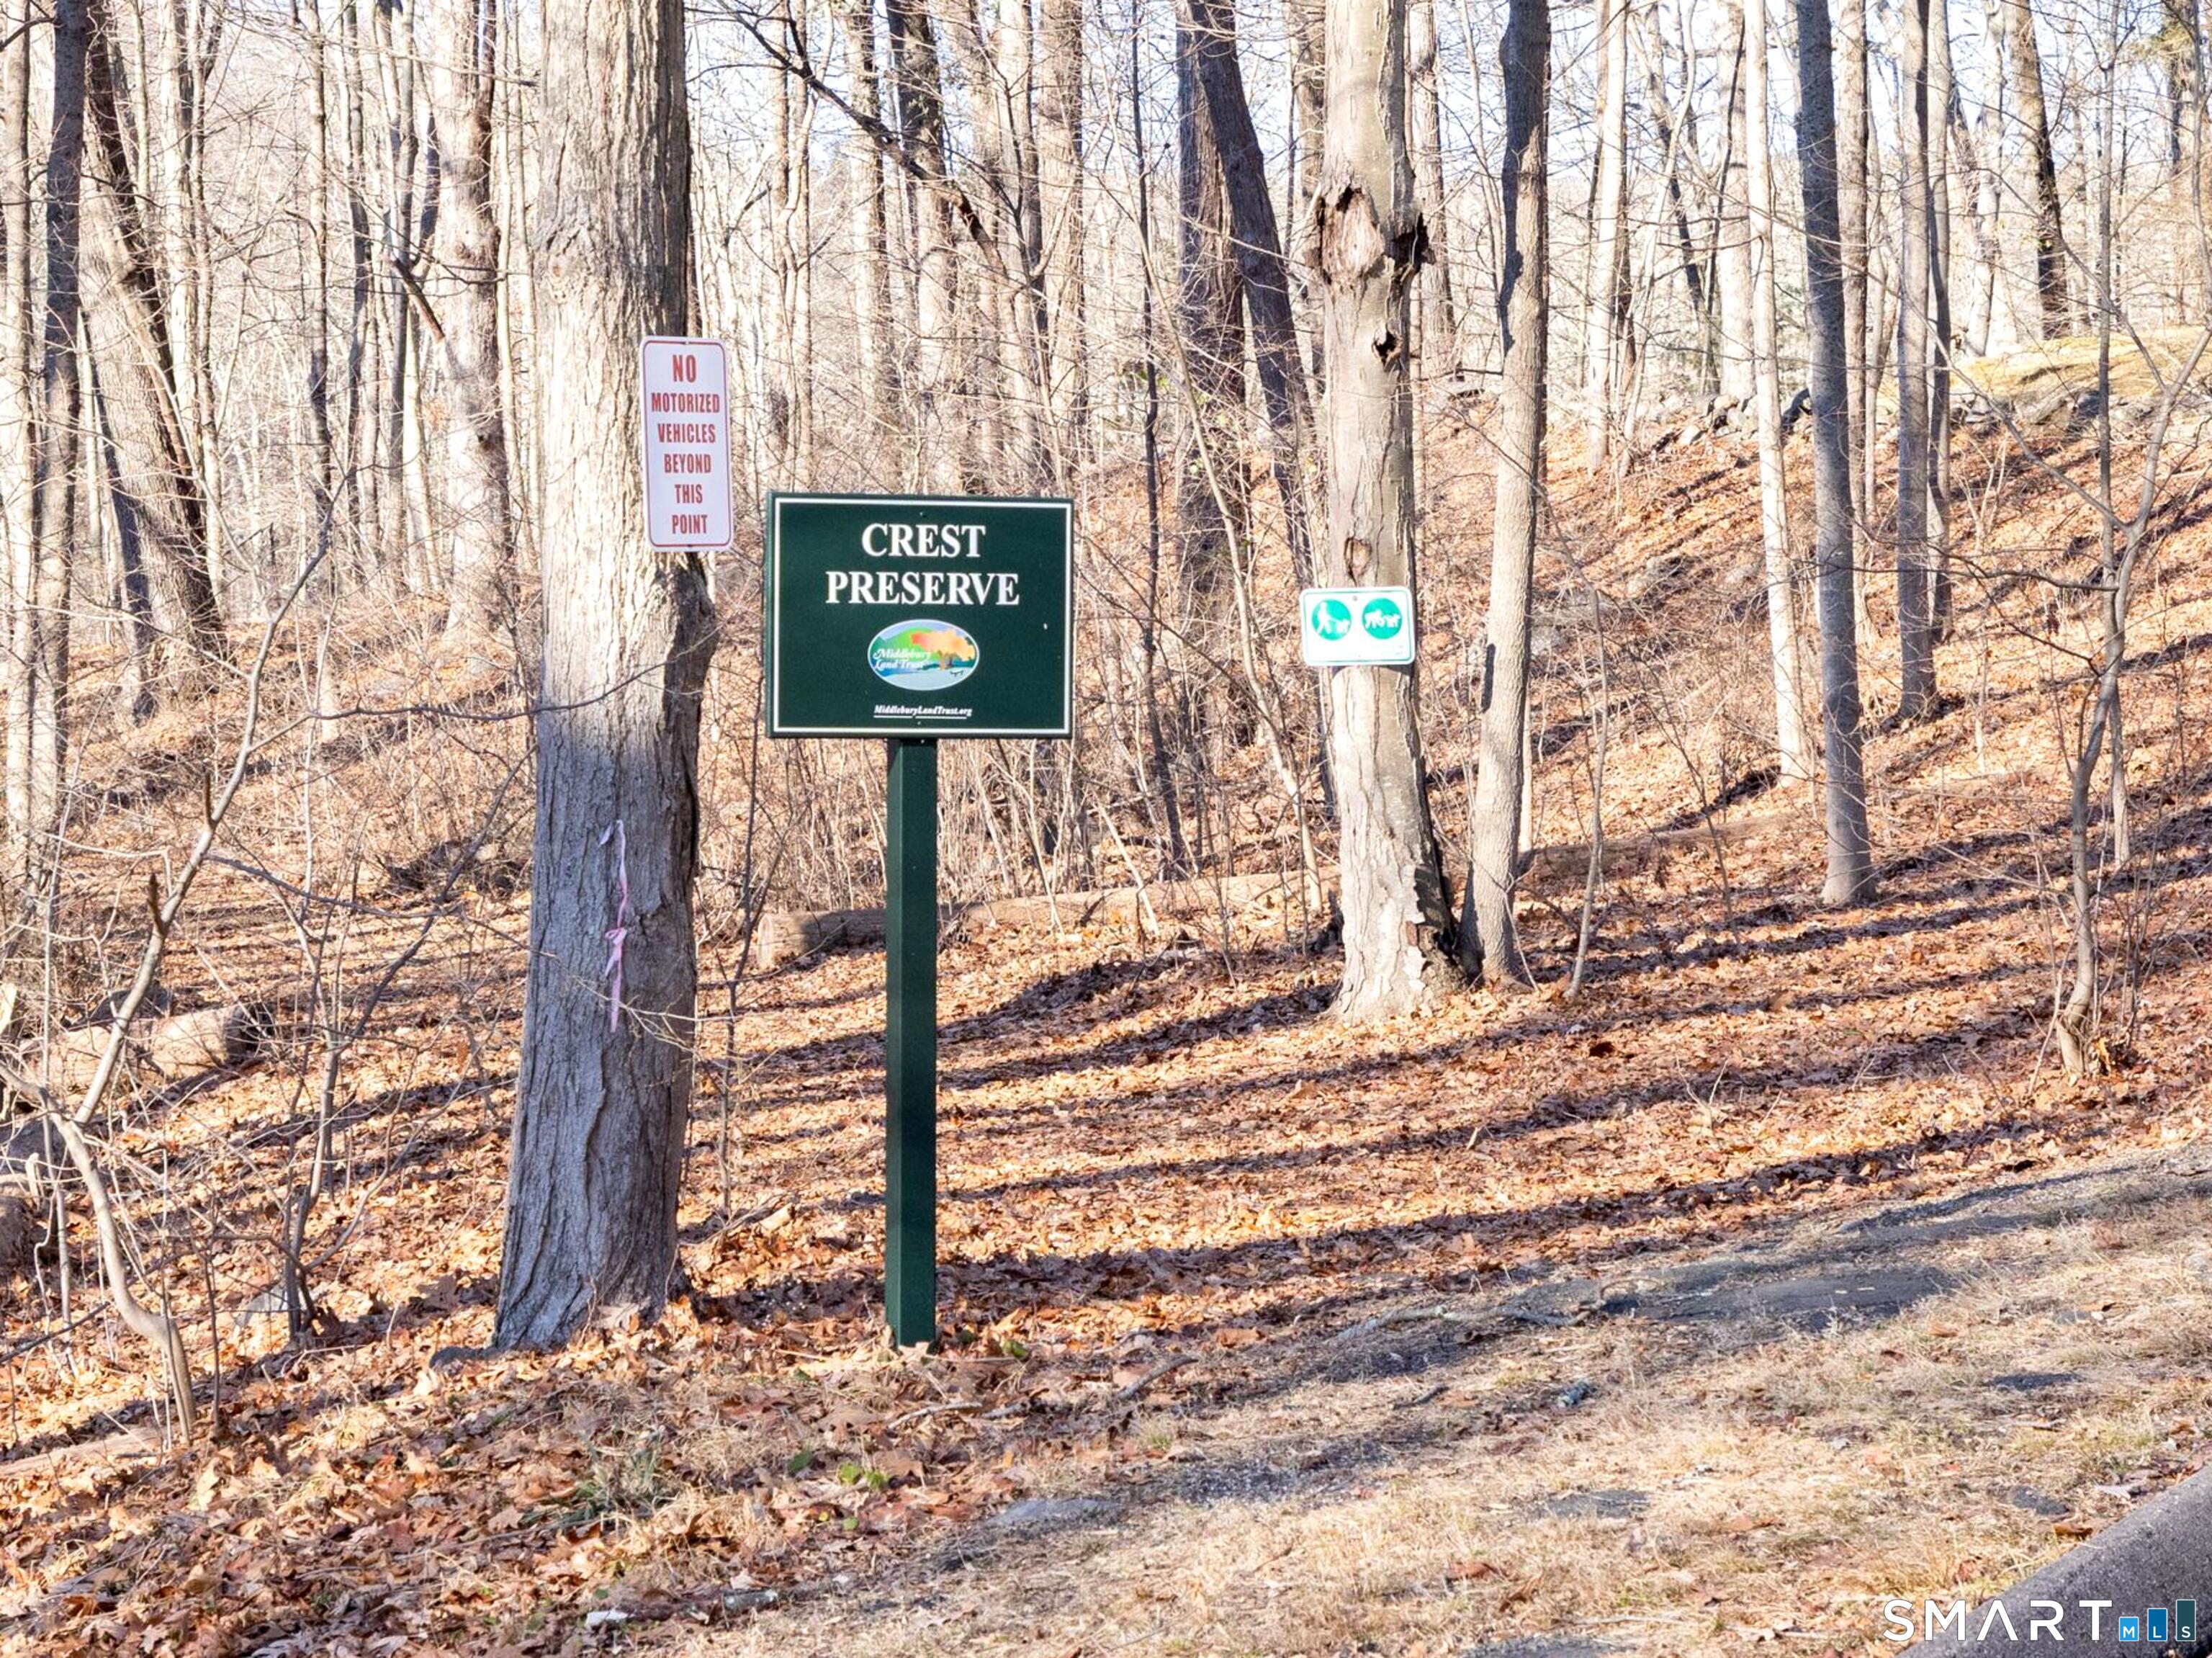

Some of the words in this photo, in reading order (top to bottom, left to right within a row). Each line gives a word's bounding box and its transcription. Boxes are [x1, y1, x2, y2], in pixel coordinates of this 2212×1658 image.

[672, 354, 697, 383] NO
[651, 393, 720, 413] MOTORIZED
[657, 423, 716, 444] VEHICLES
[664, 453, 711, 473] BEYOND
[674, 484, 703, 504] THIS
[672, 514, 708, 534] POINT
[861, 523, 986, 558] CREST
[825, 570, 1020, 606] PRESERVE
[873, 648, 930, 661] Middlebury
[875, 659, 898, 671] Land
[900, 659, 925, 669] Trust
[873, 704, 973, 717] MiddleburyLandTrust.org
